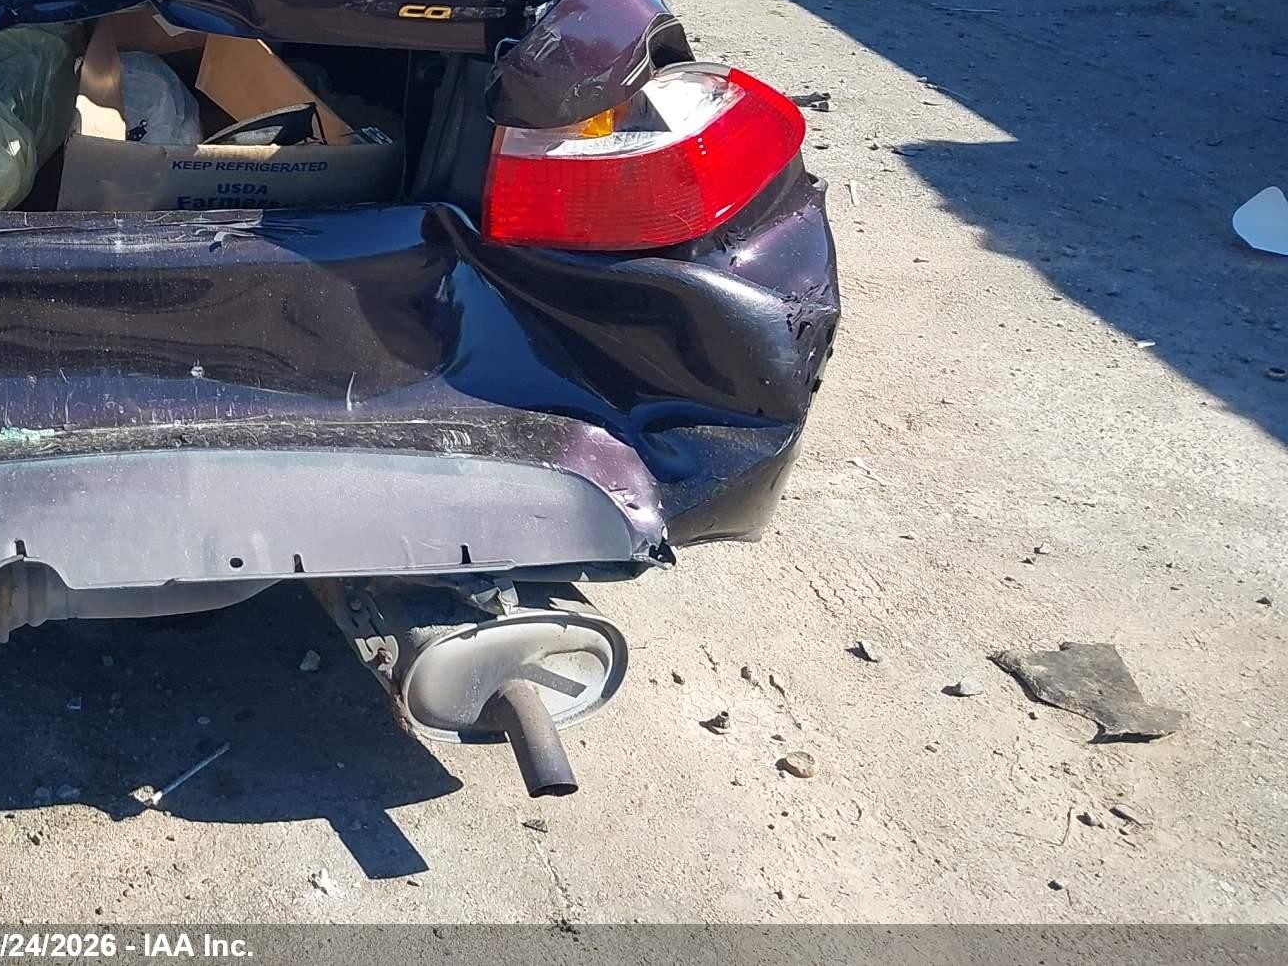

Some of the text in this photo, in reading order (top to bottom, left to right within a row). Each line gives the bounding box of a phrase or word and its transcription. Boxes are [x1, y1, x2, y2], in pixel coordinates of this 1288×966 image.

[171, 161, 328, 172] KEEP REFRIGERATED
[217, 183, 268, 195] USDA
